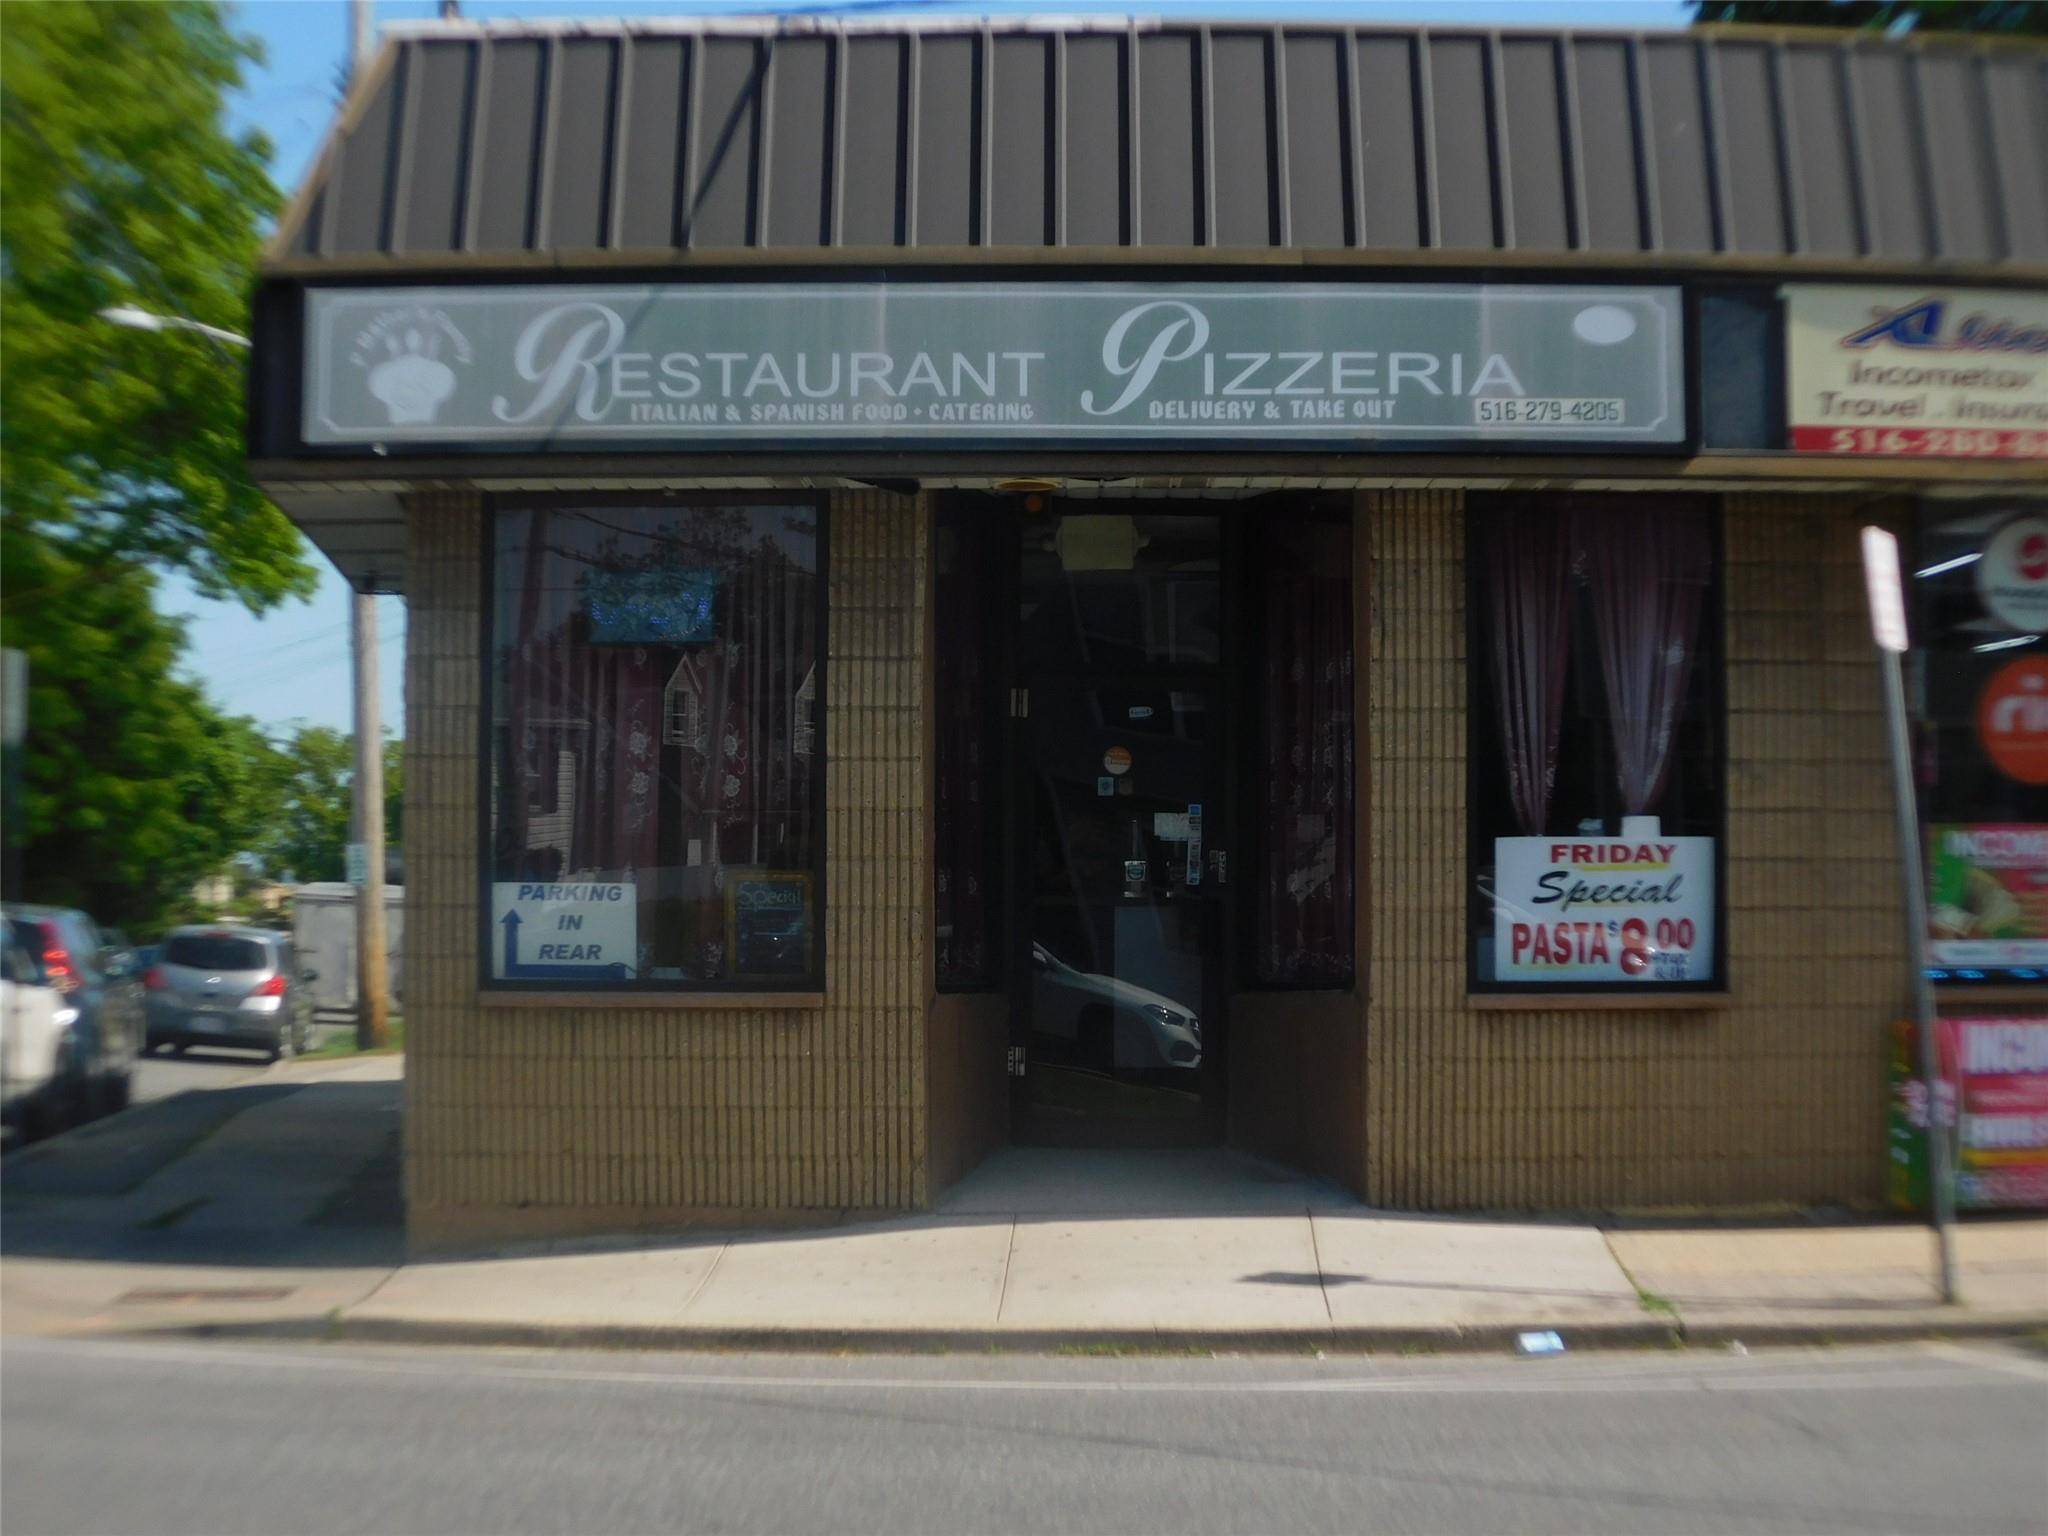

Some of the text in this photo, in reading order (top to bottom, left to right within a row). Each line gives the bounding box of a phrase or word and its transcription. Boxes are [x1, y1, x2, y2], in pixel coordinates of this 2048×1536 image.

[492, 302, 1046, 422] RESTAURANT
[1081, 301, 1525, 415] PIZZERIA
[630, 402, 1035, 422] ITALIAN & SPANISH FOOD CATERING
[1149, 399, 1397, 420] DELIVERY & TAKE OUT
[1480, 401, 1619, 421] 516-279-4205
[1550, 844, 1676, 864] FRIDAY
[518, 884, 623, 901] PARKING
[1531, 871, 1684, 912] Special
[557, 914, 583, 931] IN
[537, 944, 603, 960] REAR
[1511, 921, 1610, 966] PASTA
